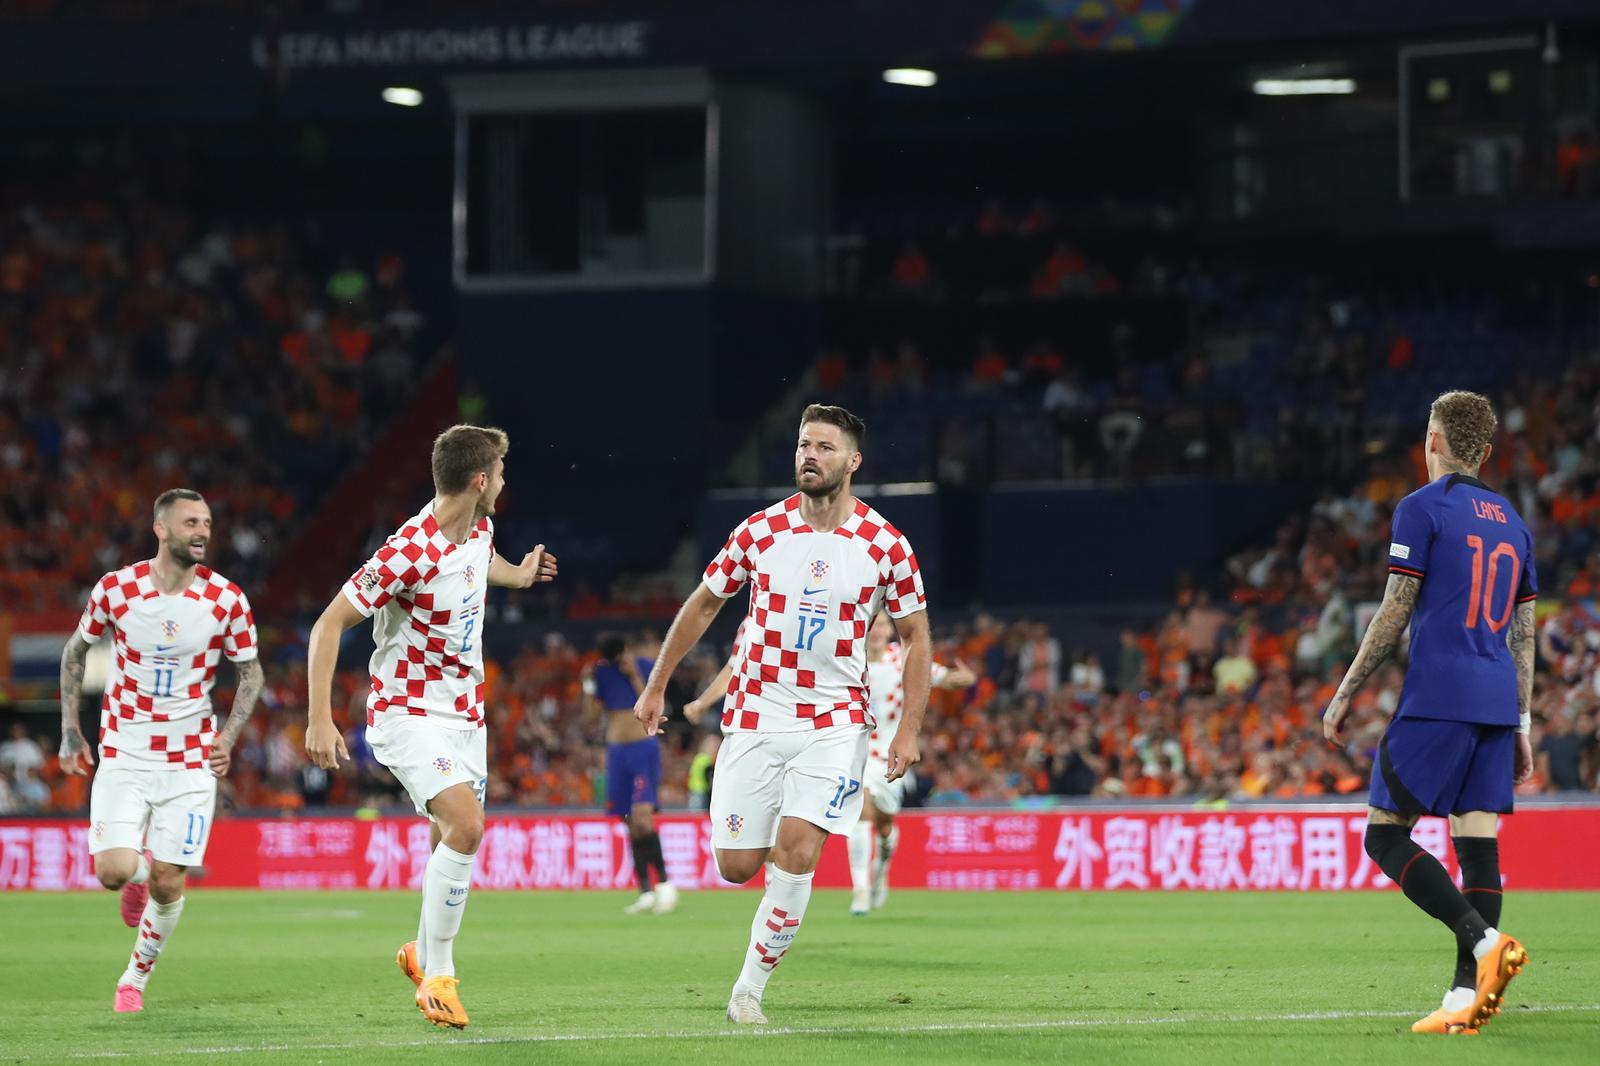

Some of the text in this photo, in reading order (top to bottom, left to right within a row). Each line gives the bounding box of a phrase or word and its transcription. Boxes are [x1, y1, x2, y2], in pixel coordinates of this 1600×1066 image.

[345, 26, 501, 64] NATIONS
[507, 20, 647, 59] LEAGUE
[1472, 498, 1507, 523] LANG
[1465, 535, 1520, 633] 10
[460, 618, 474, 652] 2
[795, 615, 825, 650] 17
[152, 669, 173, 697] 11
[829, 776, 860, 810] 17
[185, 813, 205, 846] 11
